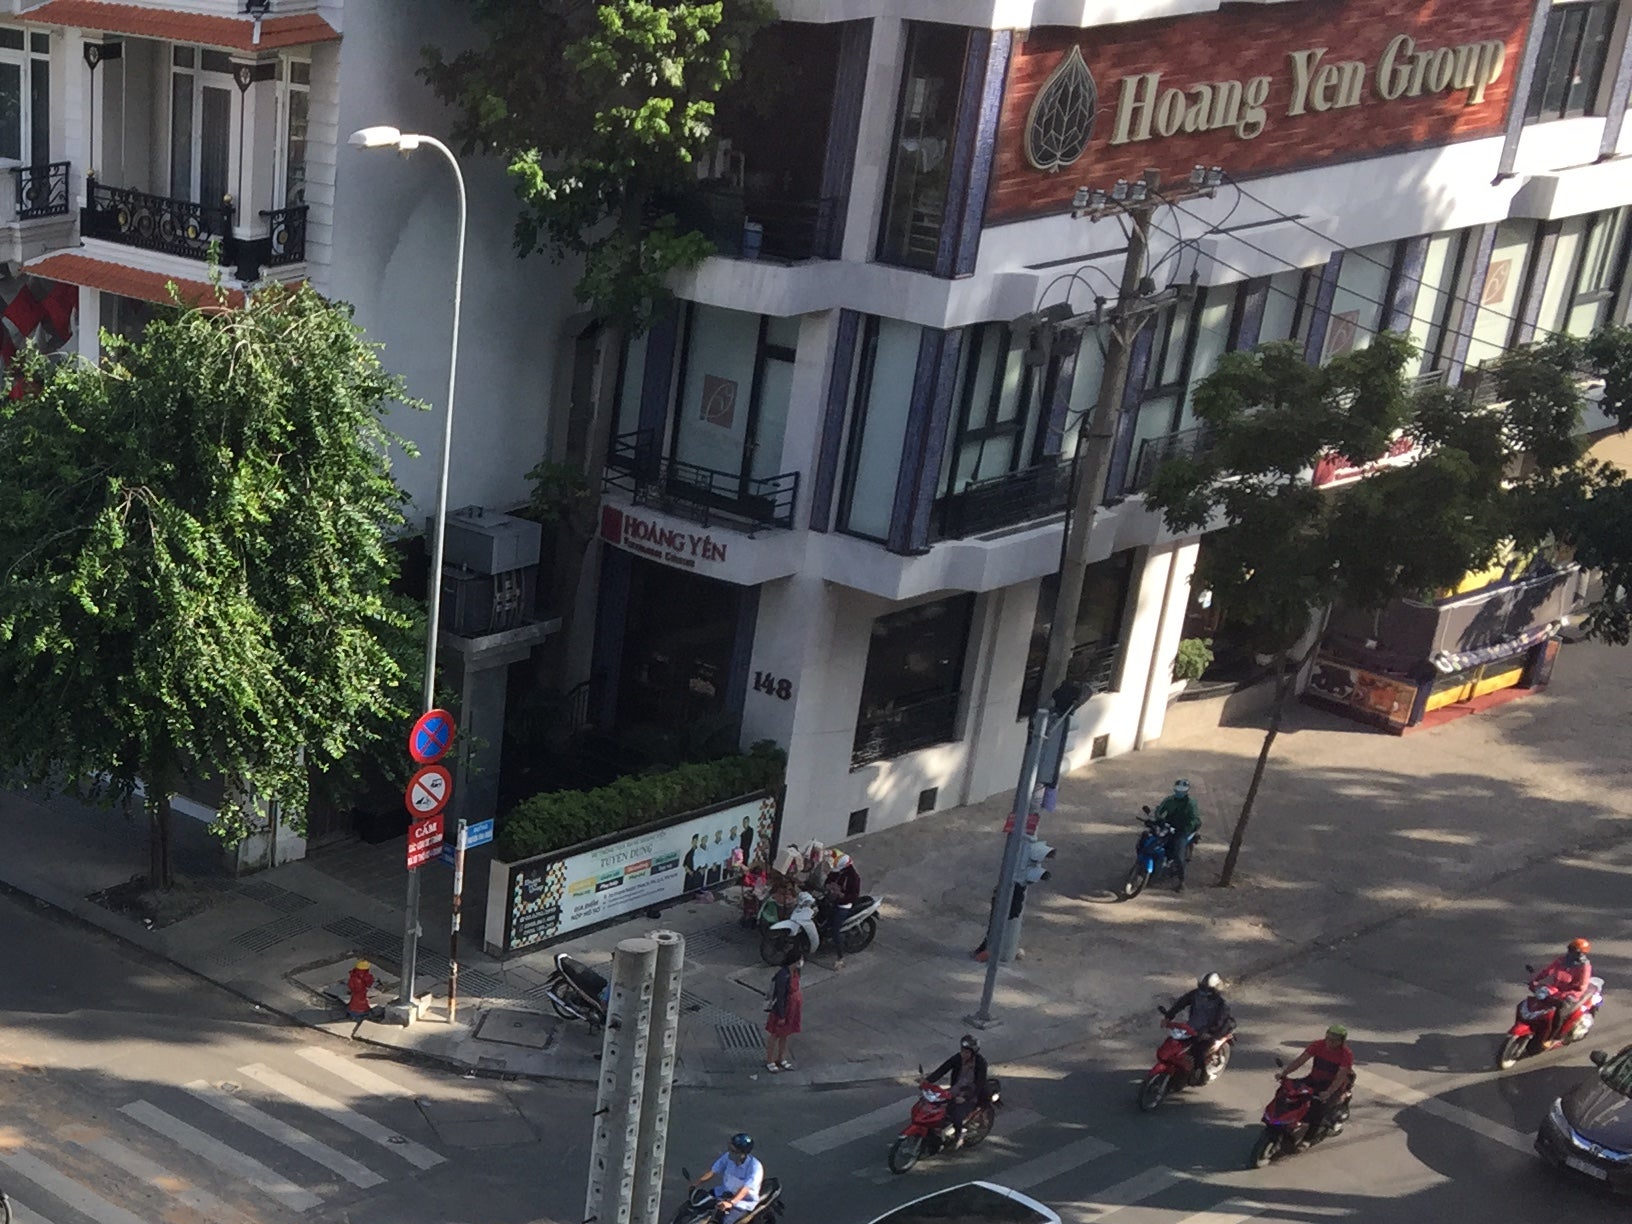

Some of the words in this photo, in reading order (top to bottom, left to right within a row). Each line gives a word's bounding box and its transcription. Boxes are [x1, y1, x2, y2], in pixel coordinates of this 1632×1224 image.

[1110, 72, 1272, 145] Hoang
[1286, 47, 1367, 117] Yen
[1378, 34, 1506, 105] Group
[753, 669, 793, 700] 148
